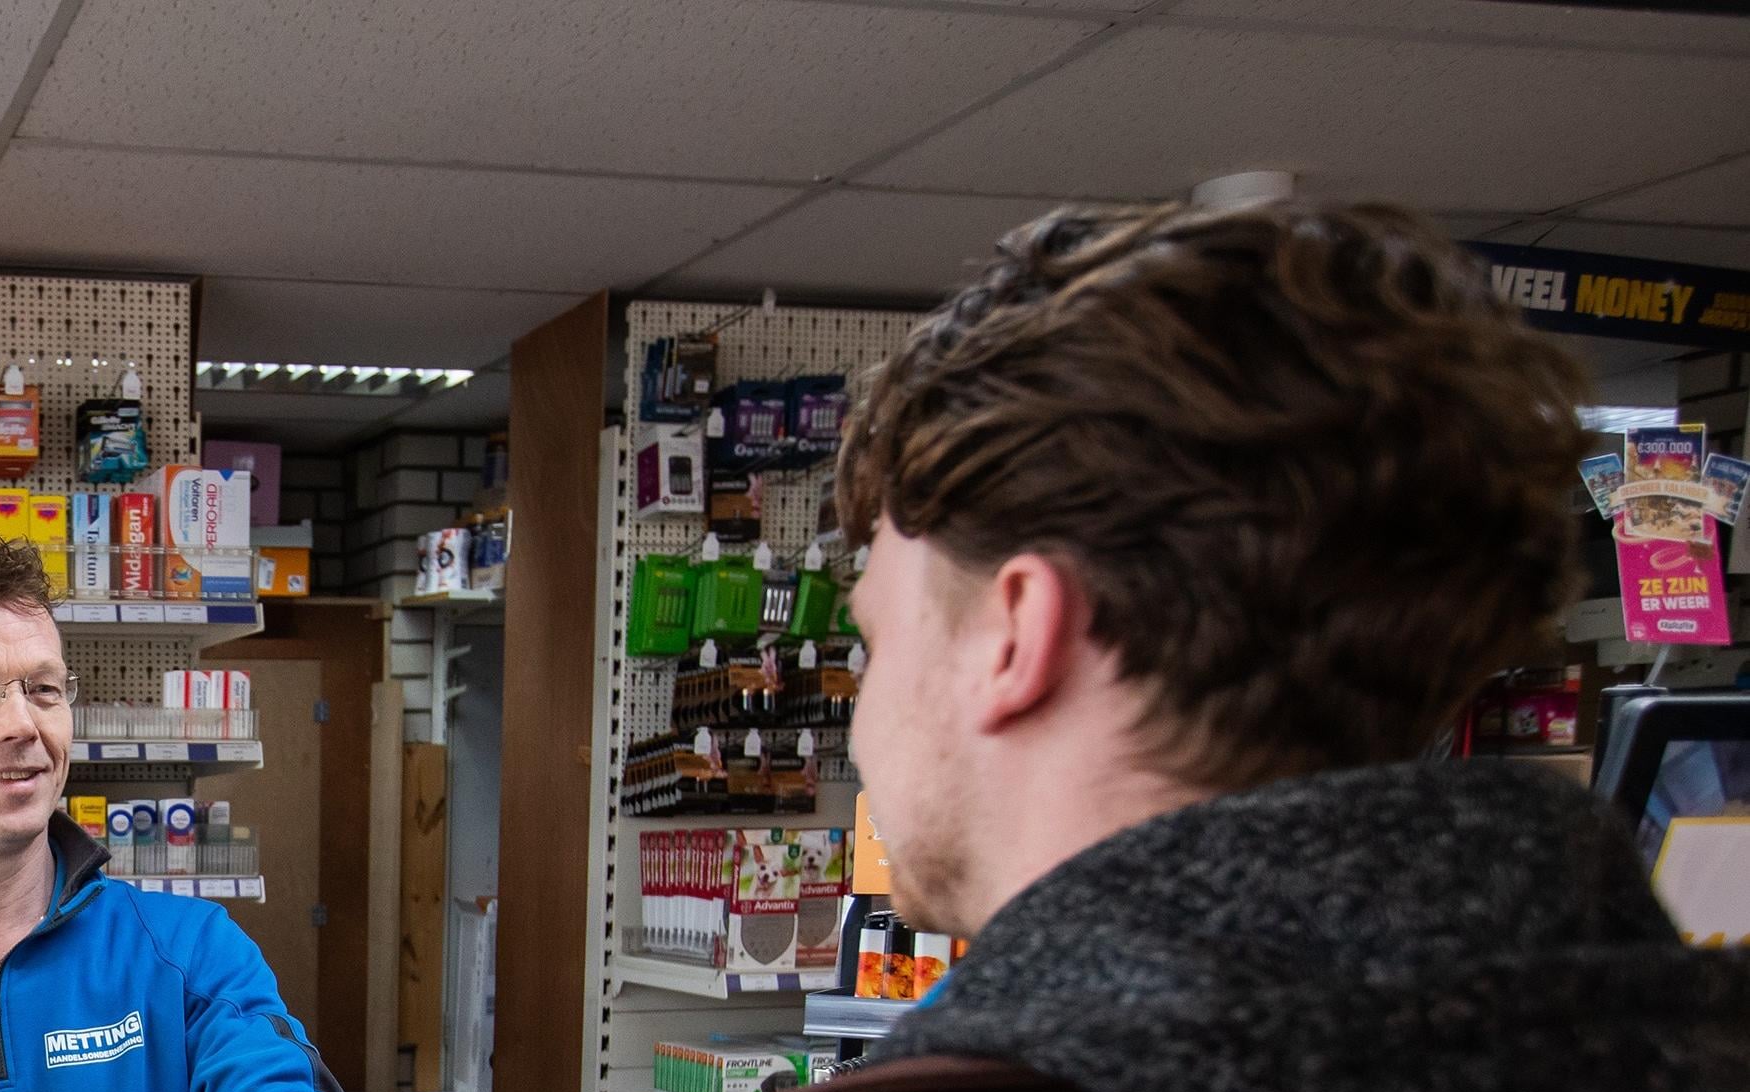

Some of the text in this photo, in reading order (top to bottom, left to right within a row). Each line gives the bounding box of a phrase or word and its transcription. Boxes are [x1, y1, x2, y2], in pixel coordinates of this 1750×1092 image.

[1492, 265, 1566, 312] VEEL
[1575, 274, 1695, 324] MONEY
[192, 478, 201, 522] Voltaren
[1639, 577, 1708, 596] ZE ZIJN
[1641, 596, 1709, 611] ER WEER!
[754, 901, 795, 911] Advantix
[48, 1016, 140, 1052] METTING
[50, 1035, 142, 1064] HANDELSONDERNEMING
[726, 1058, 773, 1068] FRONTLINE
